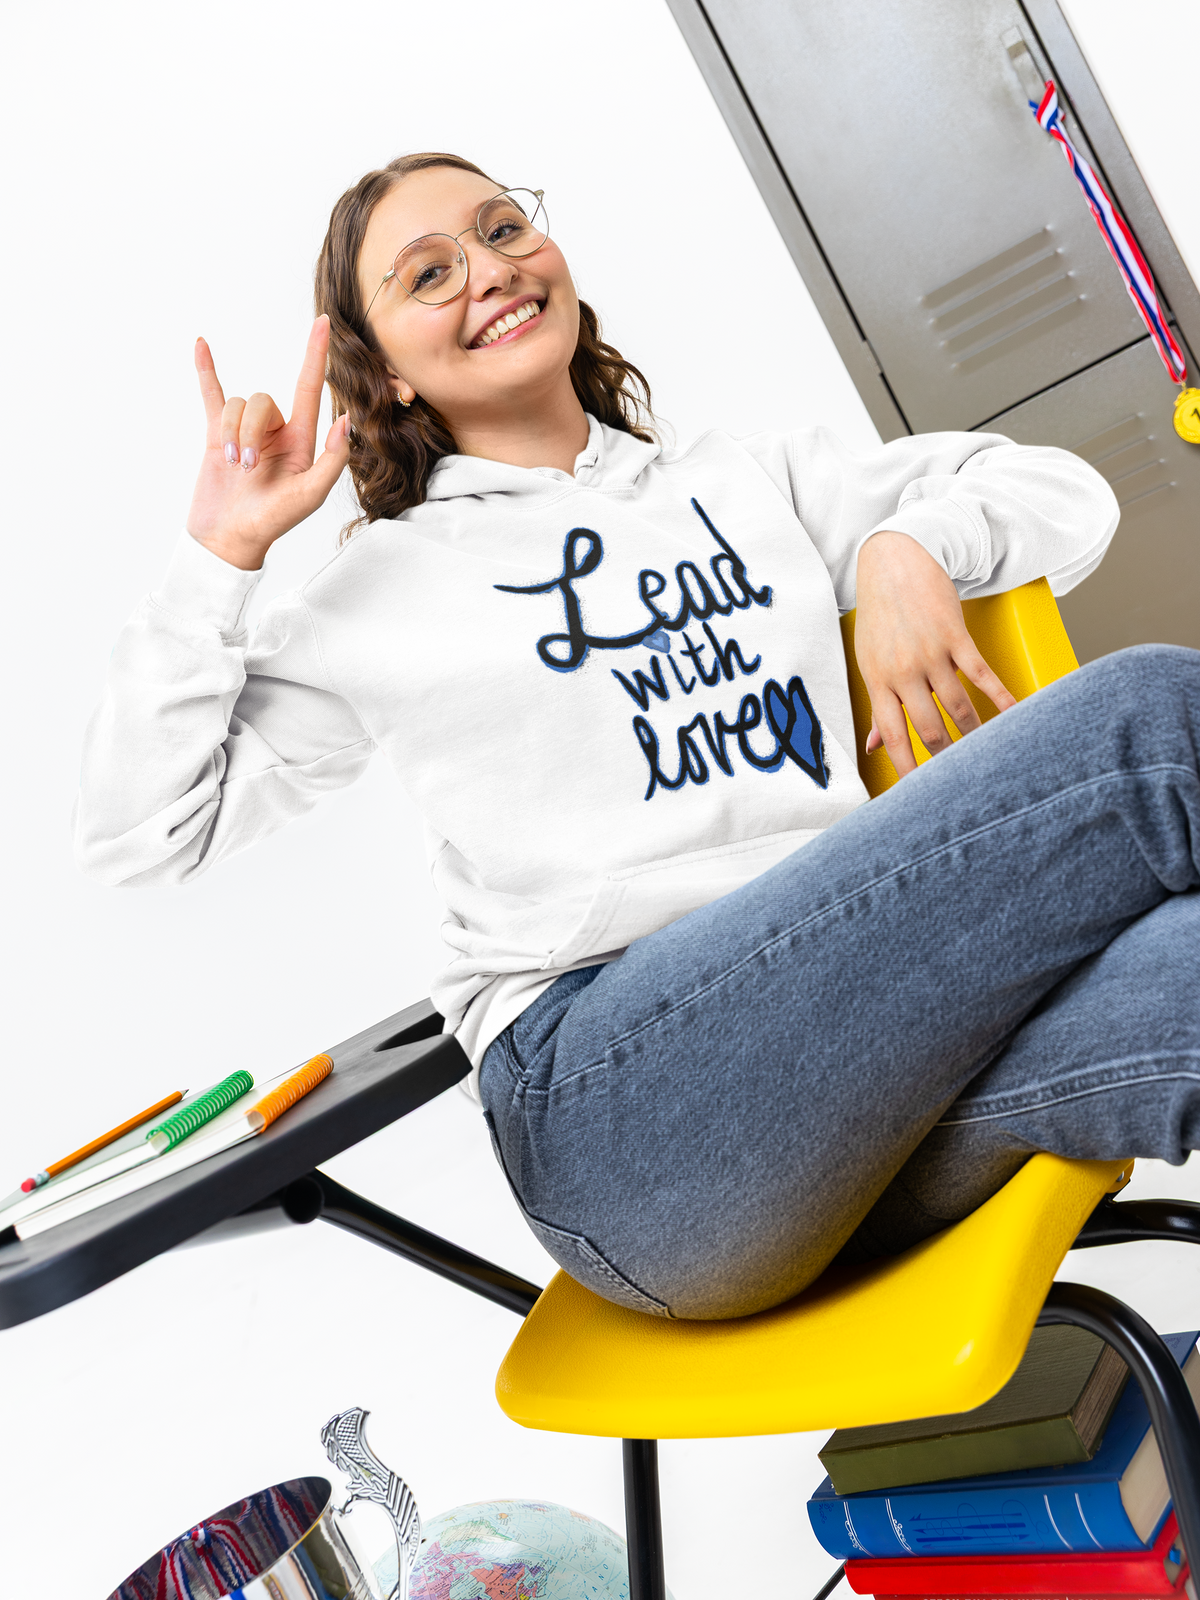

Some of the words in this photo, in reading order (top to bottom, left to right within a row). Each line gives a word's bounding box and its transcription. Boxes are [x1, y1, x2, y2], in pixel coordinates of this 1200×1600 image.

[493, 497, 773, 672] Lead
[611, 621, 762, 712] with
[632, 693, 785, 801] love
